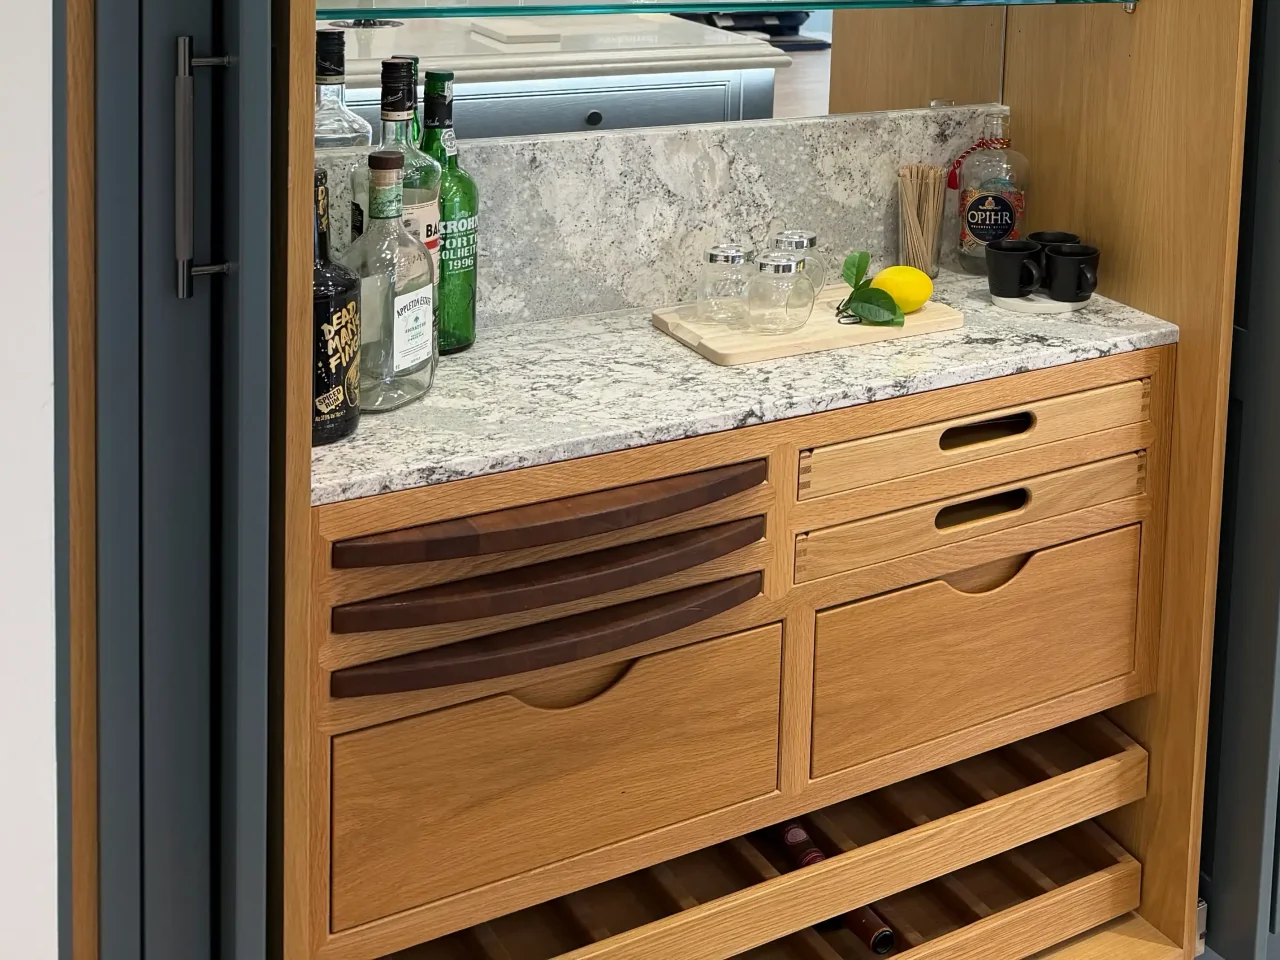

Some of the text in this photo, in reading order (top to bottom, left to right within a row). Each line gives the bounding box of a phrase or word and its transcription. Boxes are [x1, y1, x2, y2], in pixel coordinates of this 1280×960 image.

[968, 210, 1012, 224] OPIHR
[448, 256, 474, 270] 1996
[396, 298, 420, 319] APPLETON
[321, 301, 356, 341] DEAD
[329, 335, 359, 374] FING
[317, 387, 342, 406] SPICED
[325, 397, 340, 409] RUM
